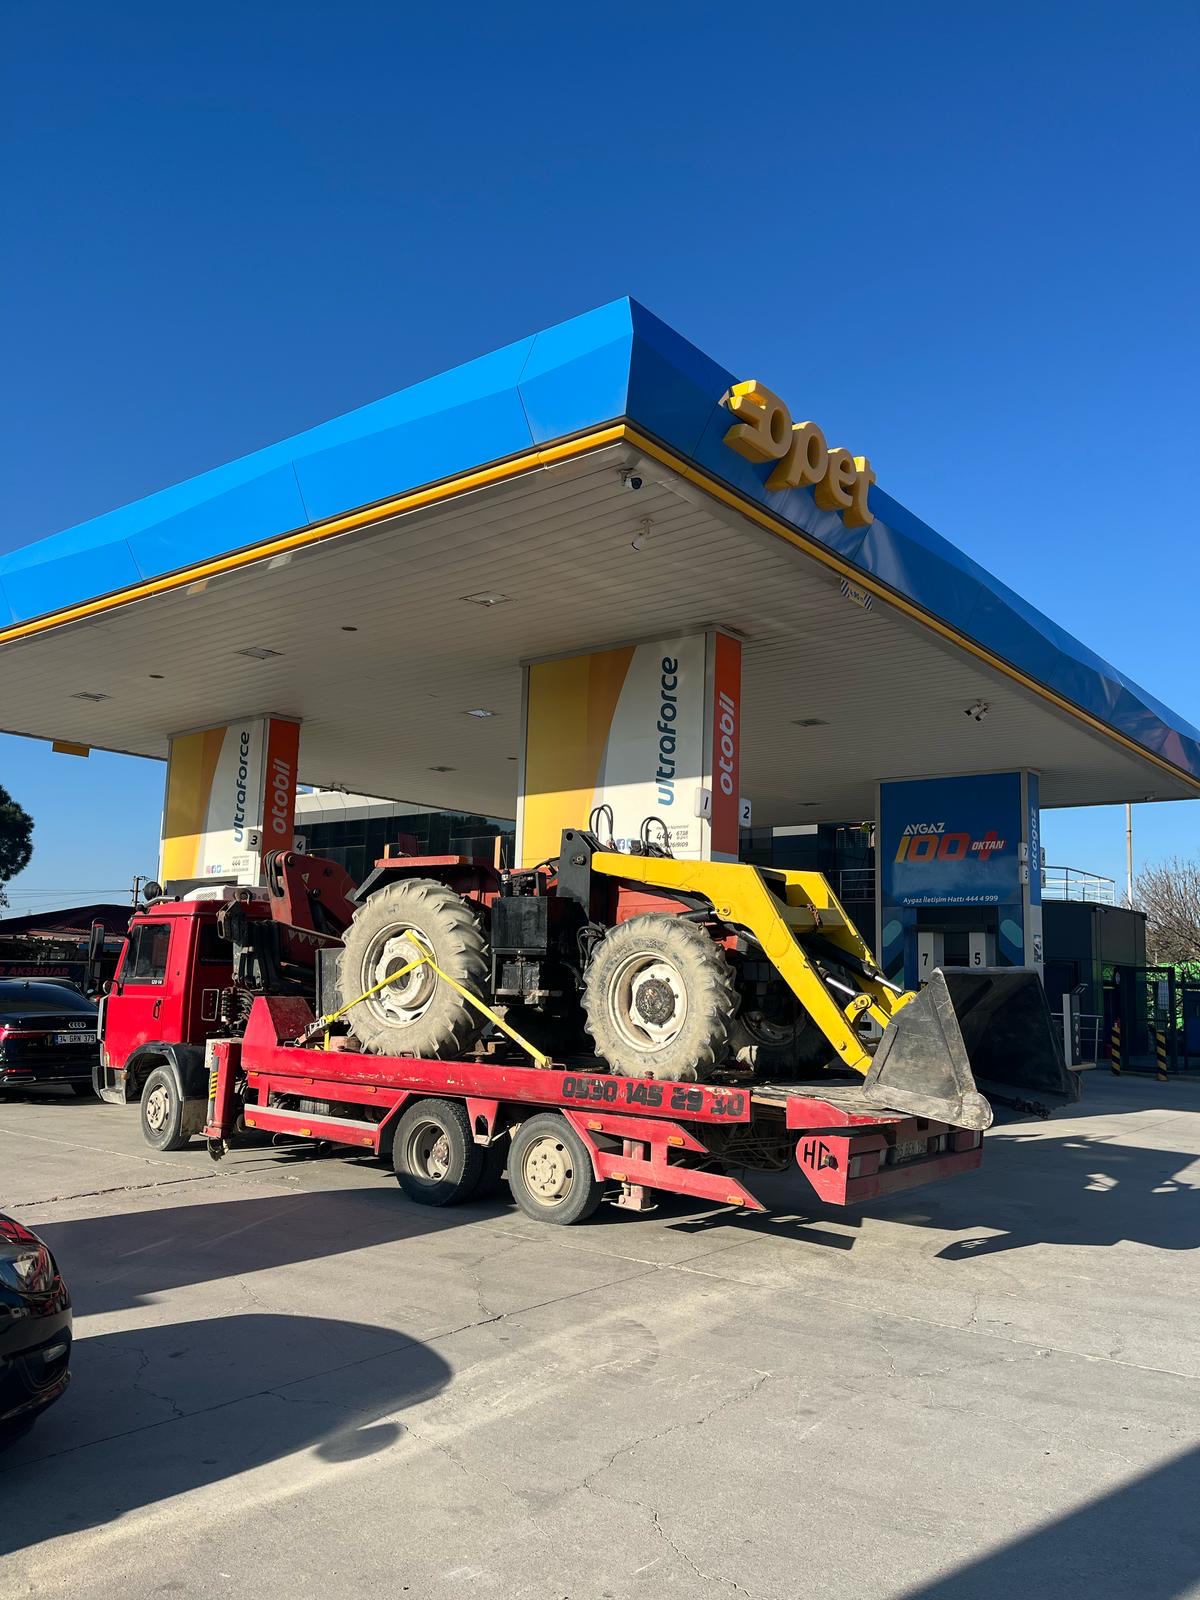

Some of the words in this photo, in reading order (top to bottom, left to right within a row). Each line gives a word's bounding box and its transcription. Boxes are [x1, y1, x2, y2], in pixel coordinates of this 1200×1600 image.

[655, 656, 679, 806] ultraforce
[719, 690, 735, 796] otobil
[233, 731, 250, 843] ultraforce
[271, 758, 291, 834] otobil
[742, 806, 750, 819] 2
[903, 822, 945, 835] AYGAZ
[250, 835, 258, 846] 3
[296, 840, 303, 851] 4
[971, 840, 1005, 851] OKTAN
[903, 897, 922, 905] Aygaz
[922, 953, 929, 966] 7
[974, 952, 981, 965] 5
[9, 967, 70, 976] AKSESUAR
[562, 1076, 618, 1102] 0530
[626, 1082, 664, 1107] 145
[671, 1087, 703, 1112] 29
